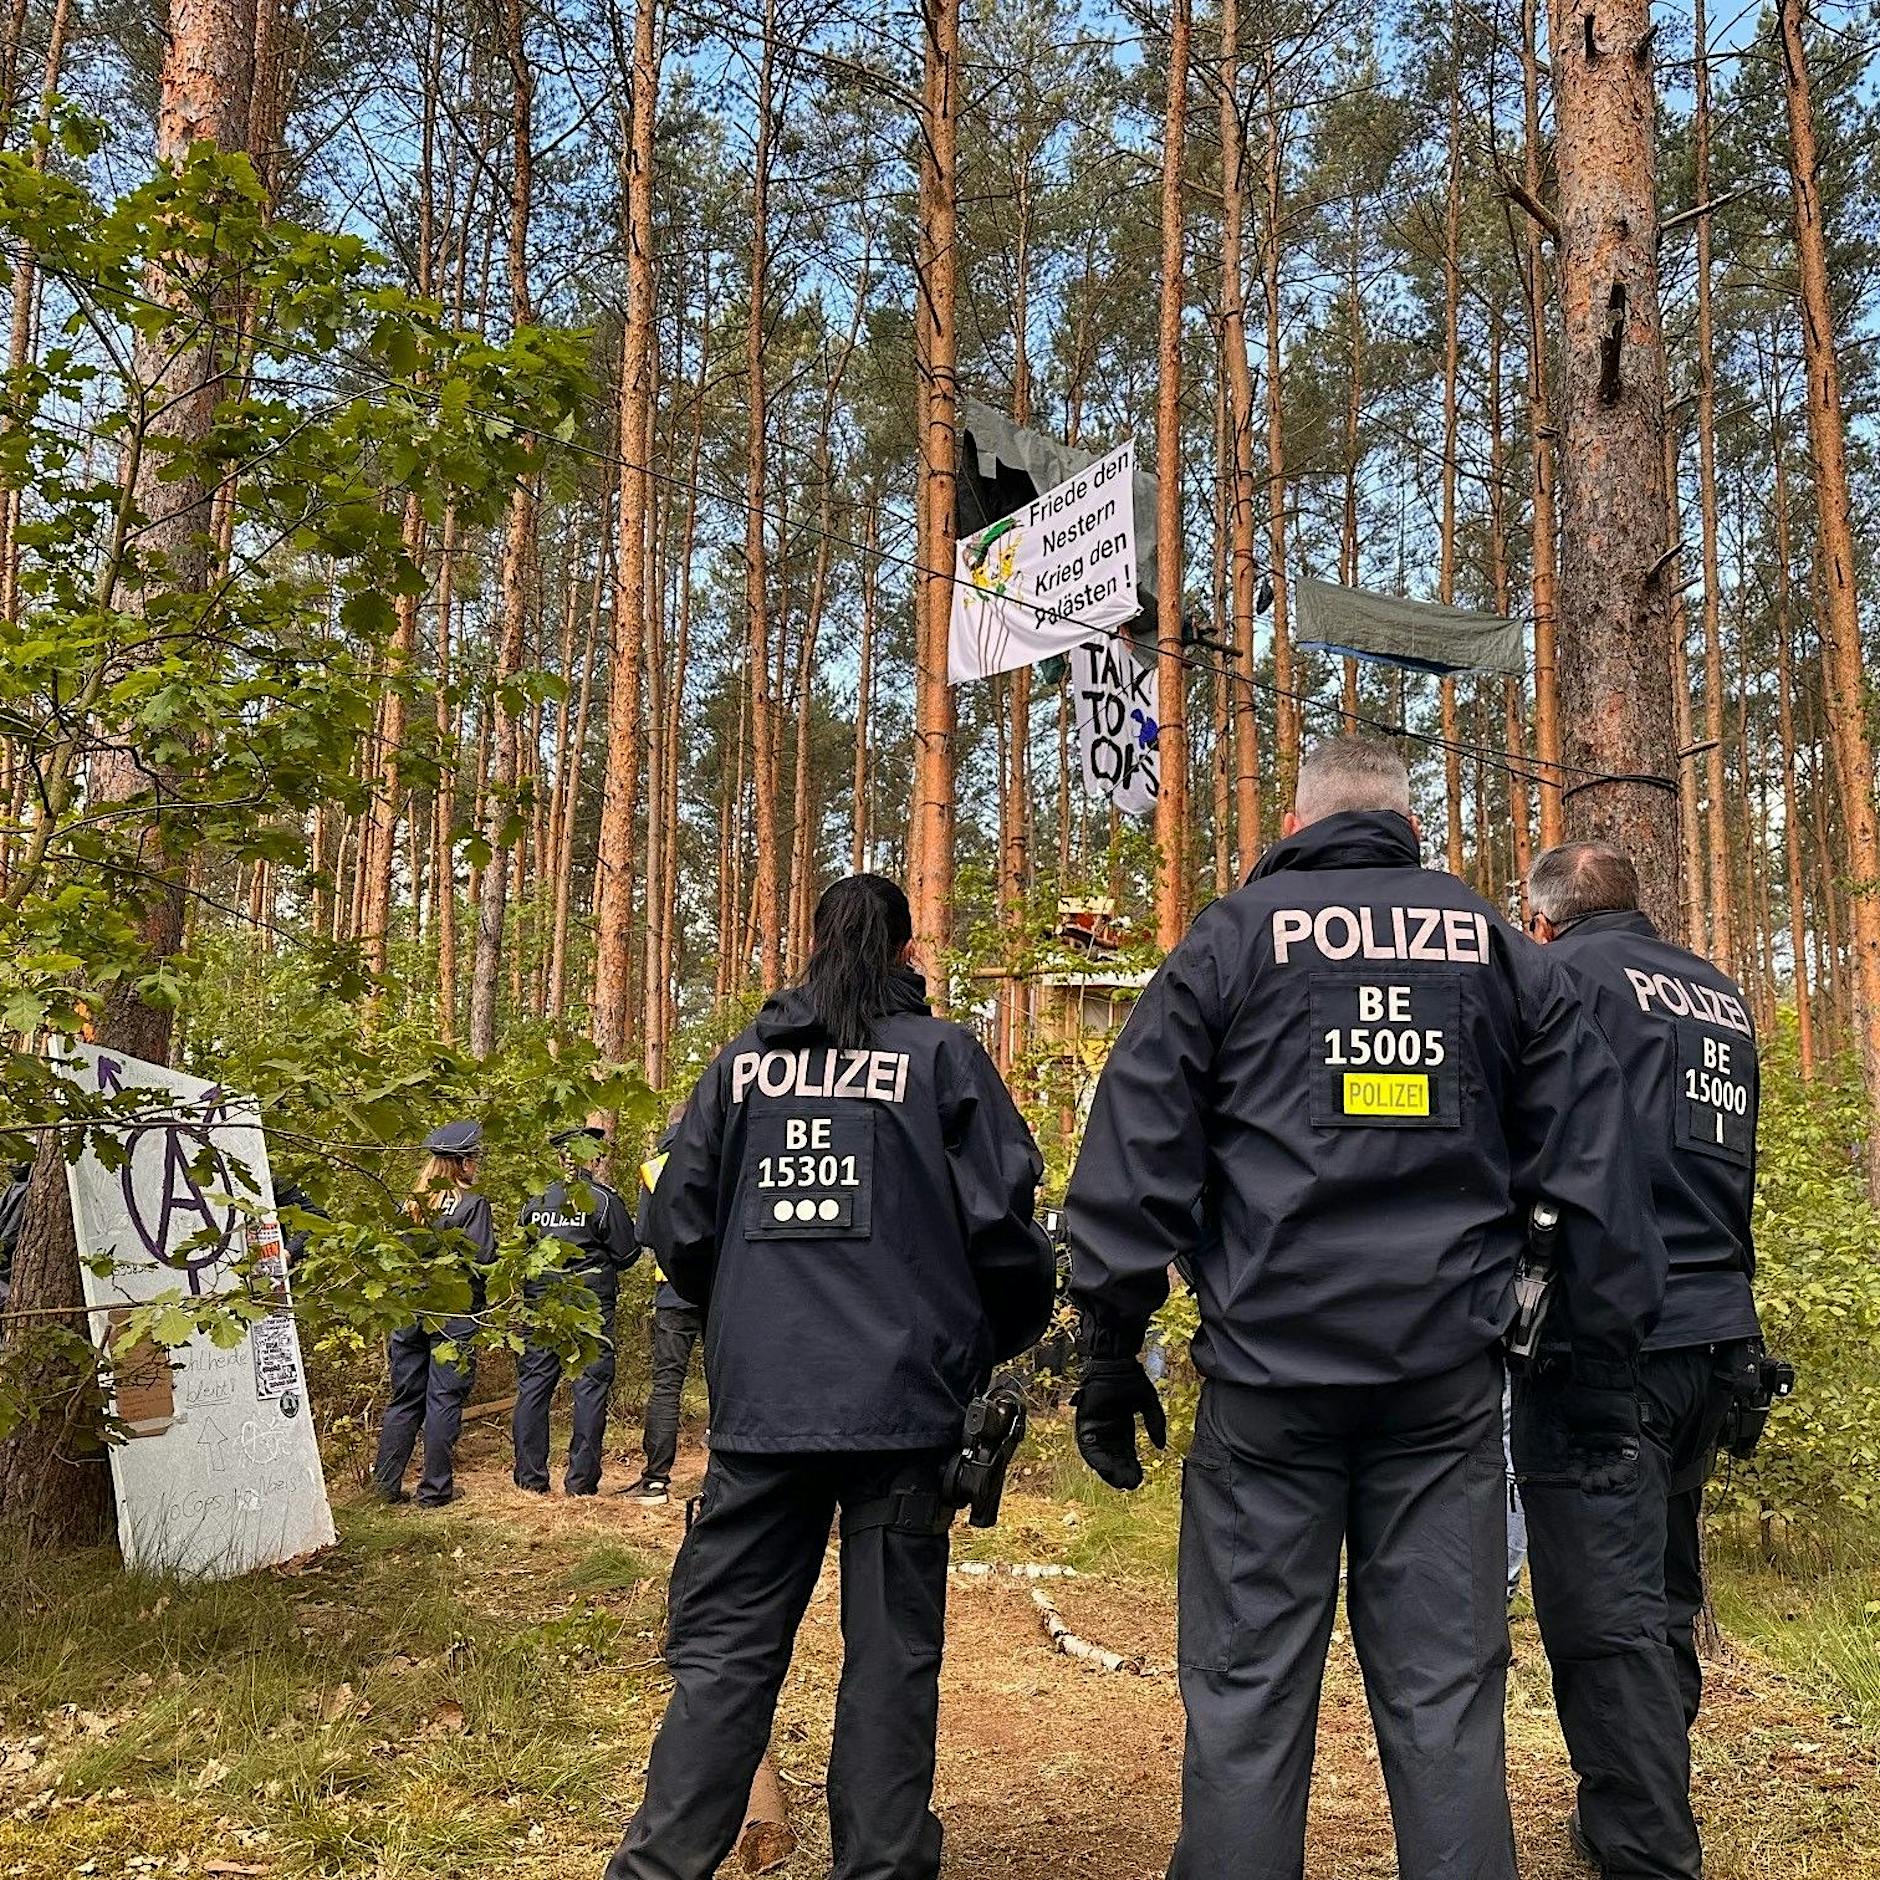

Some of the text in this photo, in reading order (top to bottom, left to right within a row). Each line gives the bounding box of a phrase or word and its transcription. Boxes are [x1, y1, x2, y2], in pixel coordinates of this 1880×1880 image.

[1029, 451, 1128, 527] Friede den
[1042, 499, 1115, 557] Nestern
[1035, 532, 1127, 597] Krieg den
[1124, 564, 1131, 588] !
[1079, 641, 1152, 707] TALK
[1081, 690, 1126, 737] TO
[1272, 905, 1490, 965] POLIZEI
[1358, 986, 1412, 1022] BE
[1623, 967, 1752, 1039] POLIZEI
[1323, 1028, 1445, 1066] 15005
[1702, 1036, 1731, 1075] BE
[732, 1048, 910, 1104] POLIZEI
[1349, 1082, 1424, 1108] POLIZEI
[1685, 1068, 1747, 1116] 15000
[785, 1117, 832, 1150] BE
[757, 1155, 860, 1188] 15301
